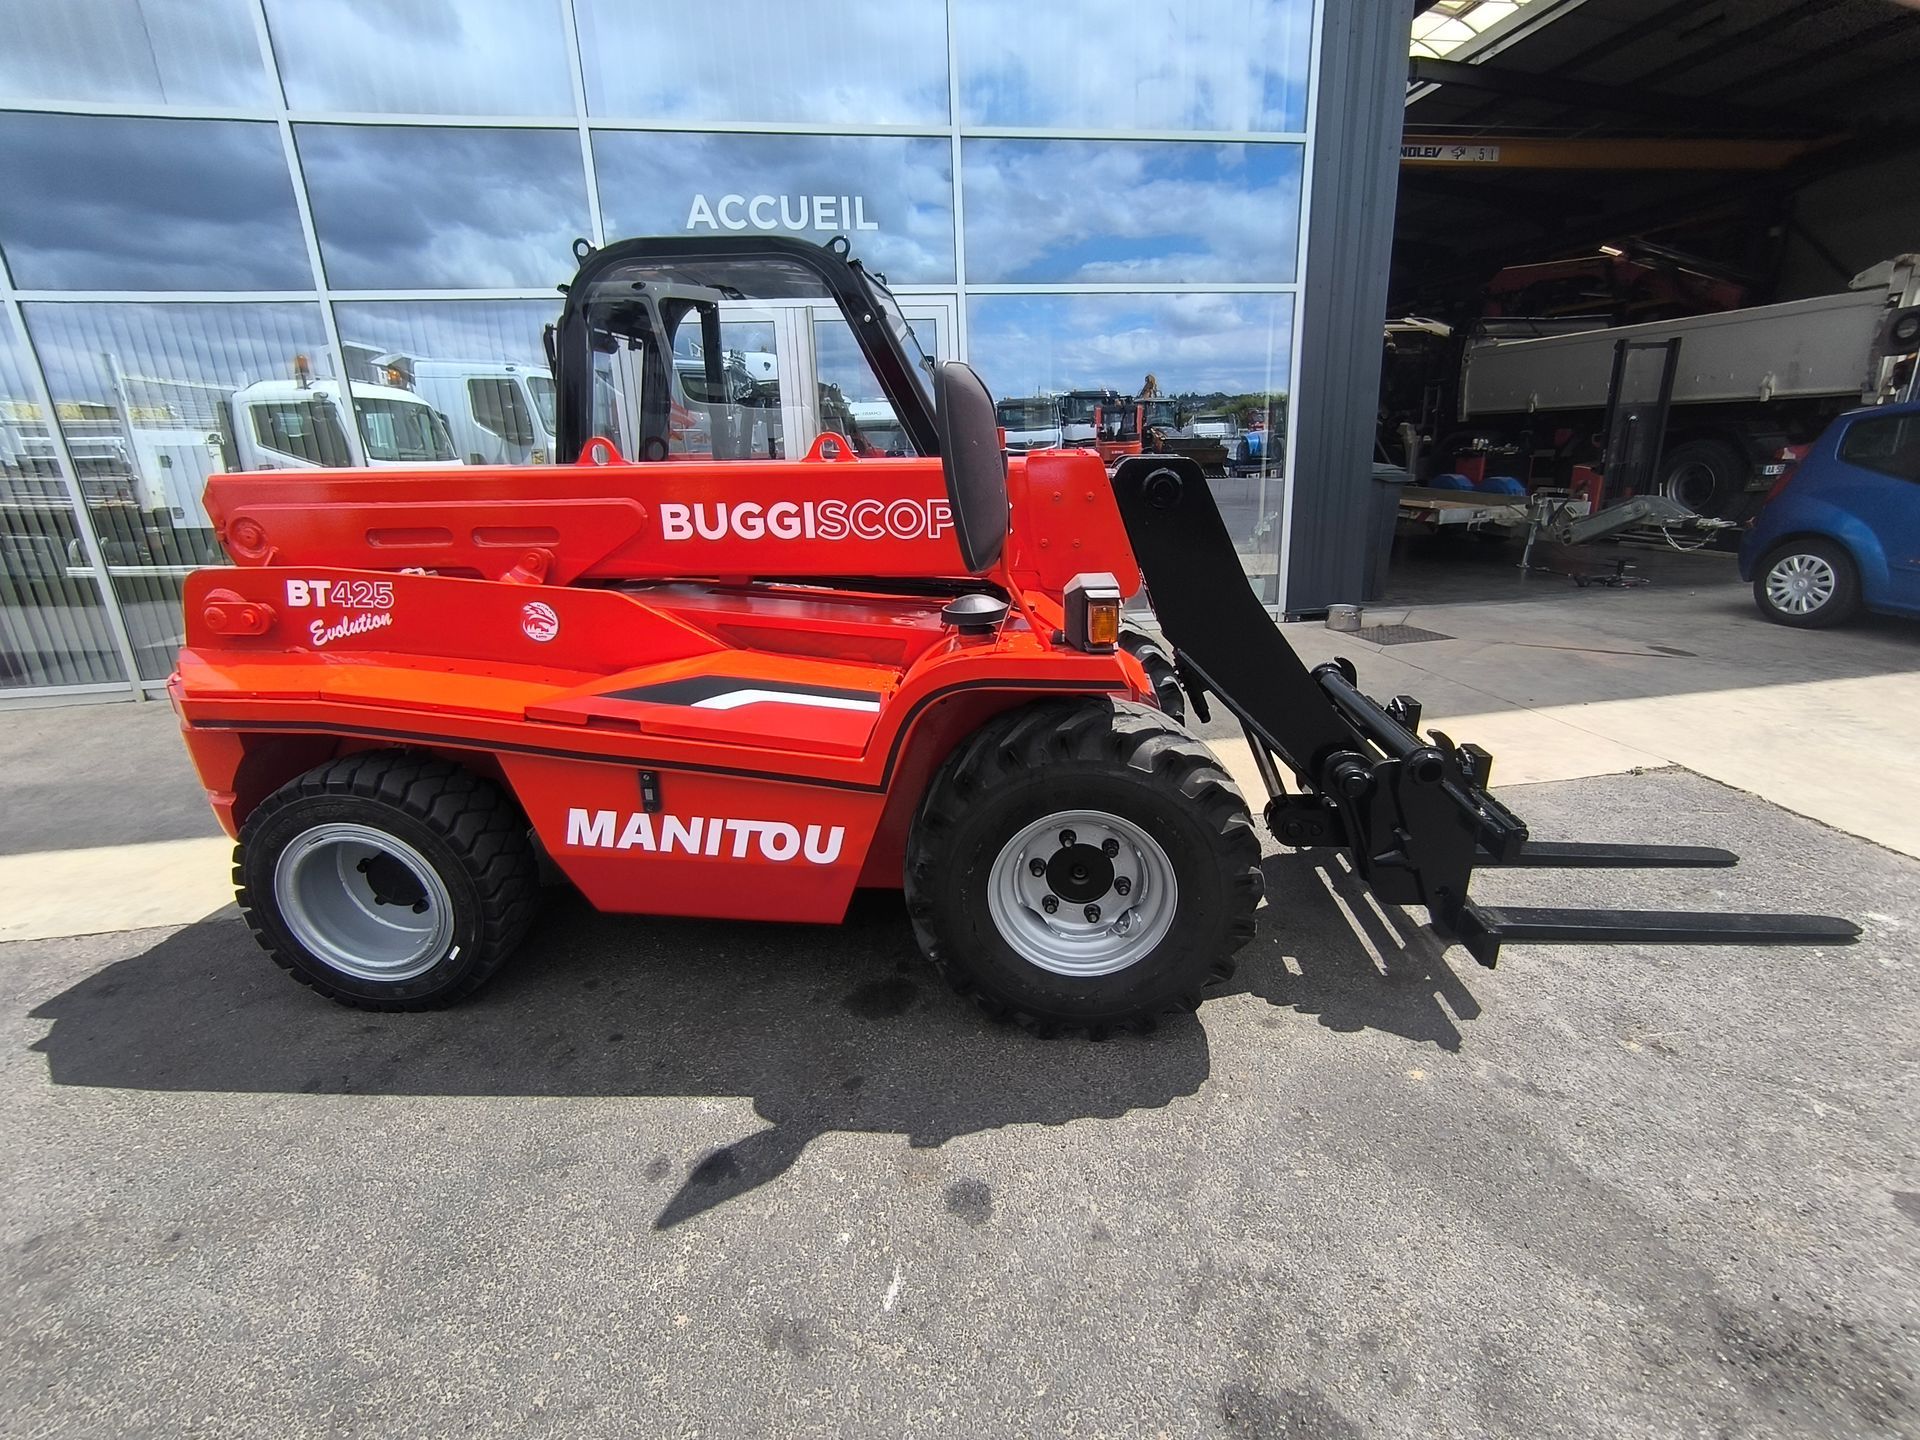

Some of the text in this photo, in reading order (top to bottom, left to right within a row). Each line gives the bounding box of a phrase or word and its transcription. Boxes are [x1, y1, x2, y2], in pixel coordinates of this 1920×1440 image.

[686, 193, 879, 231] ACCUEIL
[659, 498, 1014, 540] BUGGISCOP
[286, 579, 395, 609] BT425
[309, 612, 393, 646] Evolution
[566, 807, 846, 864] MANITOU
